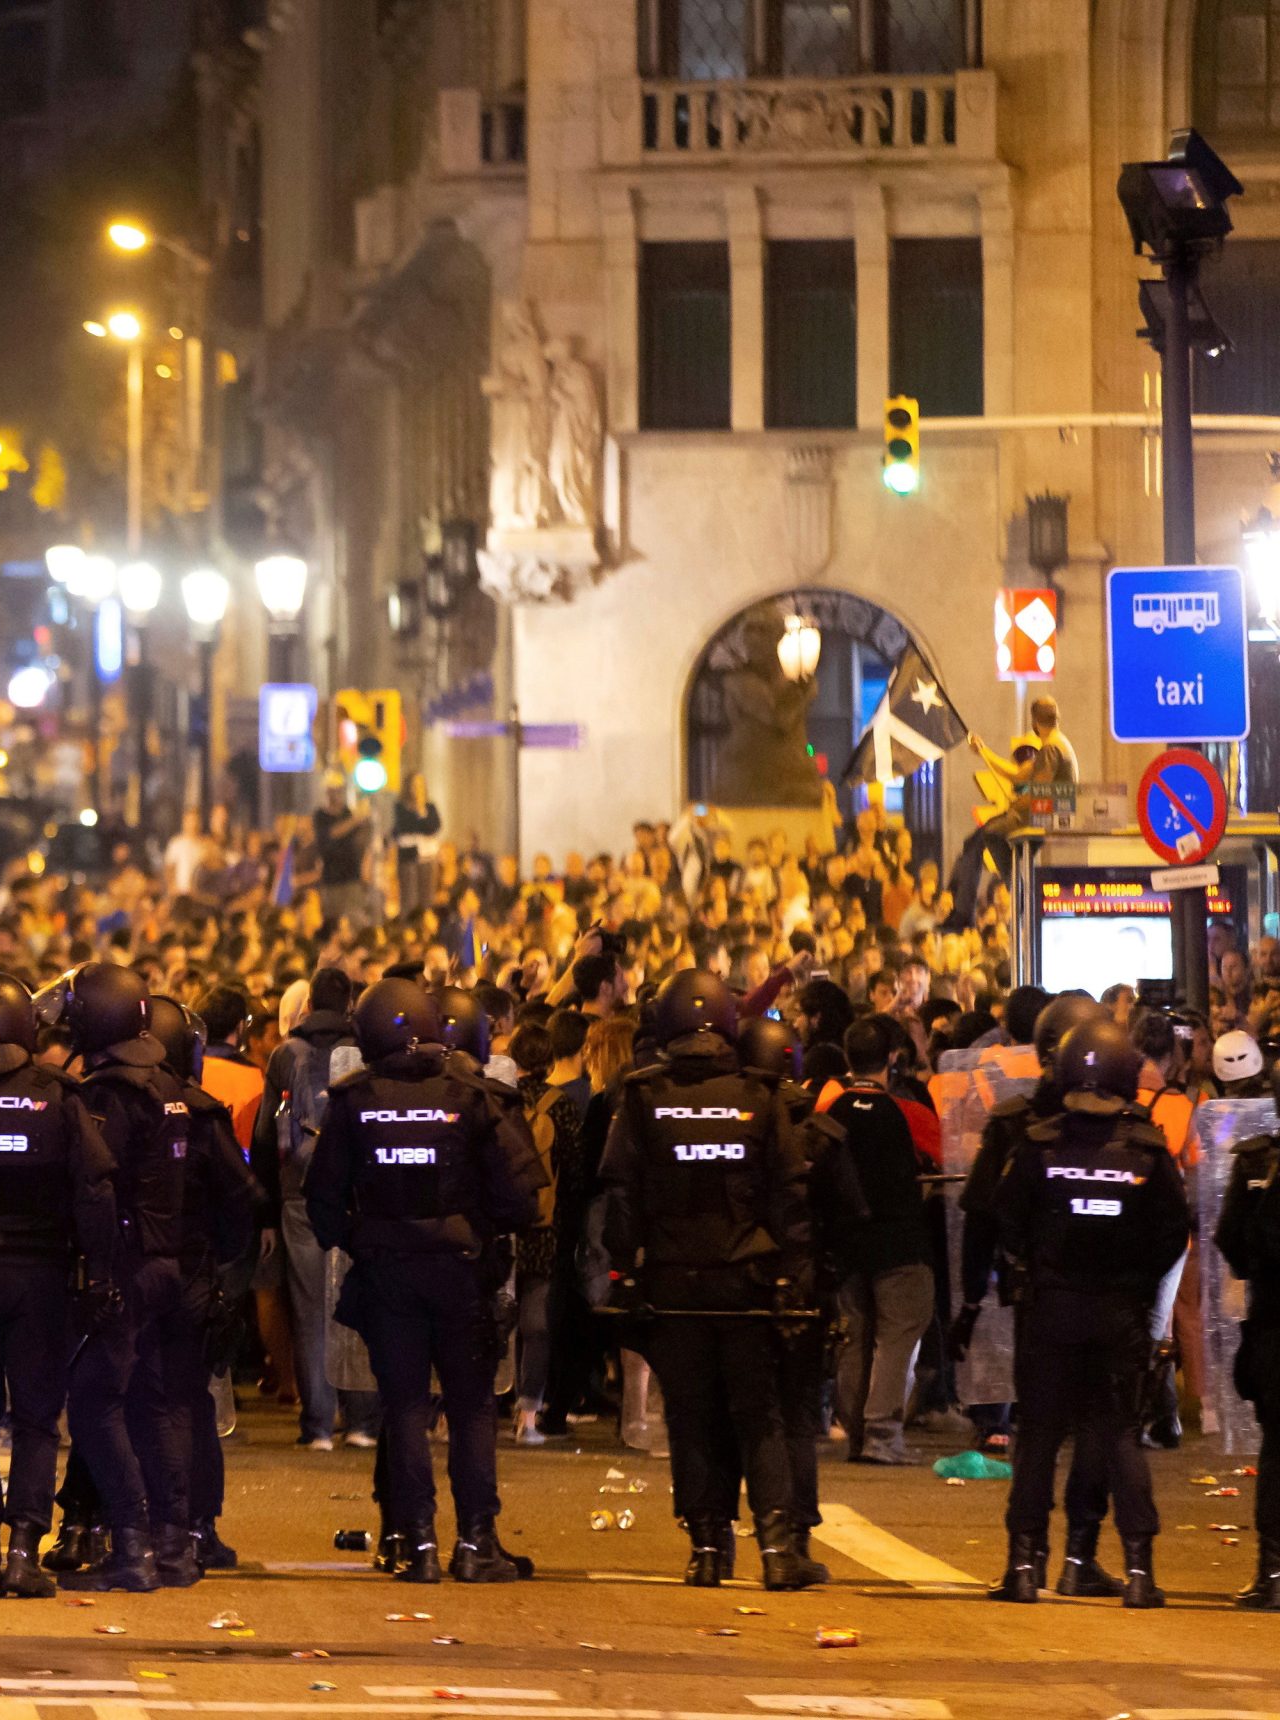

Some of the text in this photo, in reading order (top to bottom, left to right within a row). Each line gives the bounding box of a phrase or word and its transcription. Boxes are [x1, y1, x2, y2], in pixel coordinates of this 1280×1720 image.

[1155, 672, 1204, 705] taxi
[360, 1109, 449, 1123] POLICIA
[655, 1107, 741, 1119] POLICIA
[375, 1147, 436, 1164] 1U1281
[674, 1144, 745, 1161] 1U1040
[1046, 1167, 1136, 1183] POLICIA
